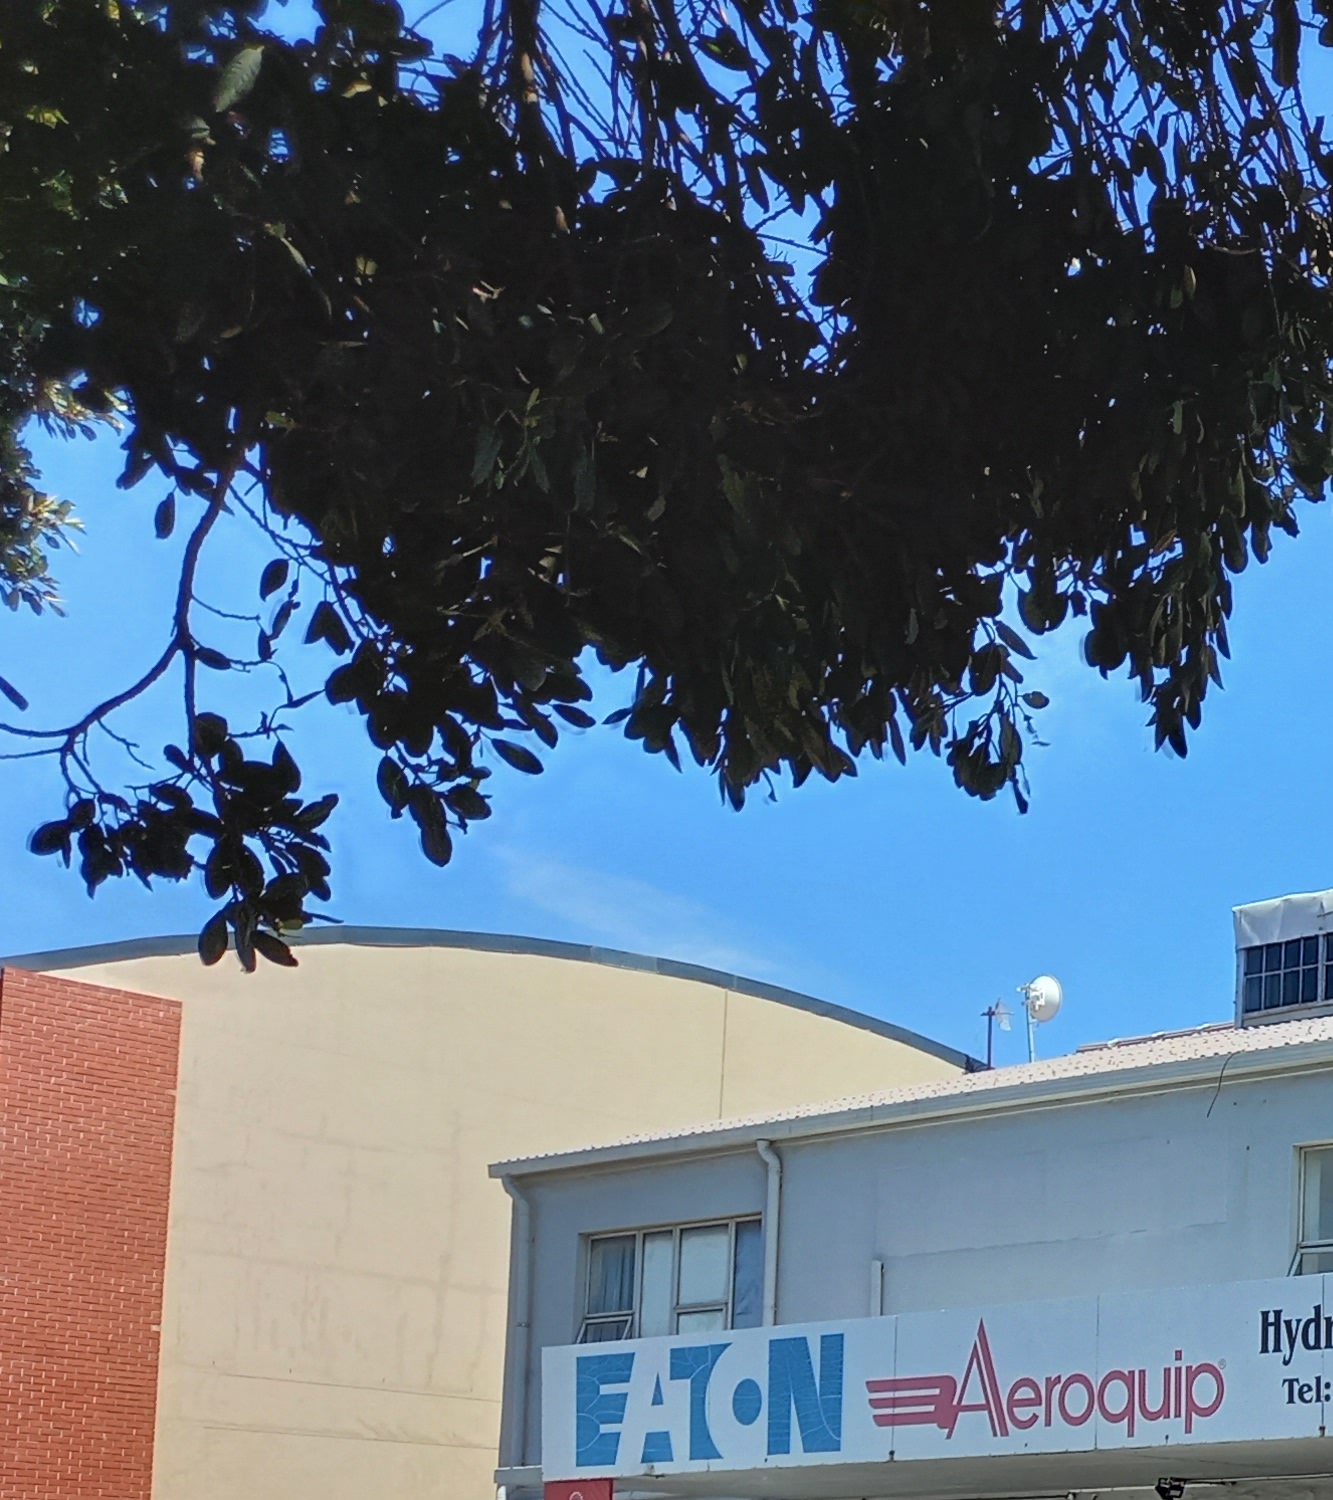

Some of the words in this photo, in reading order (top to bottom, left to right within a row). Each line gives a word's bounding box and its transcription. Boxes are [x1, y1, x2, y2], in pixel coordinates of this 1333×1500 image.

[576, 1333, 844, 1467] EATON
[945, 1317, 1225, 1440] Aeroquip
[1282, 1375, 1332, 1405] Tel:
